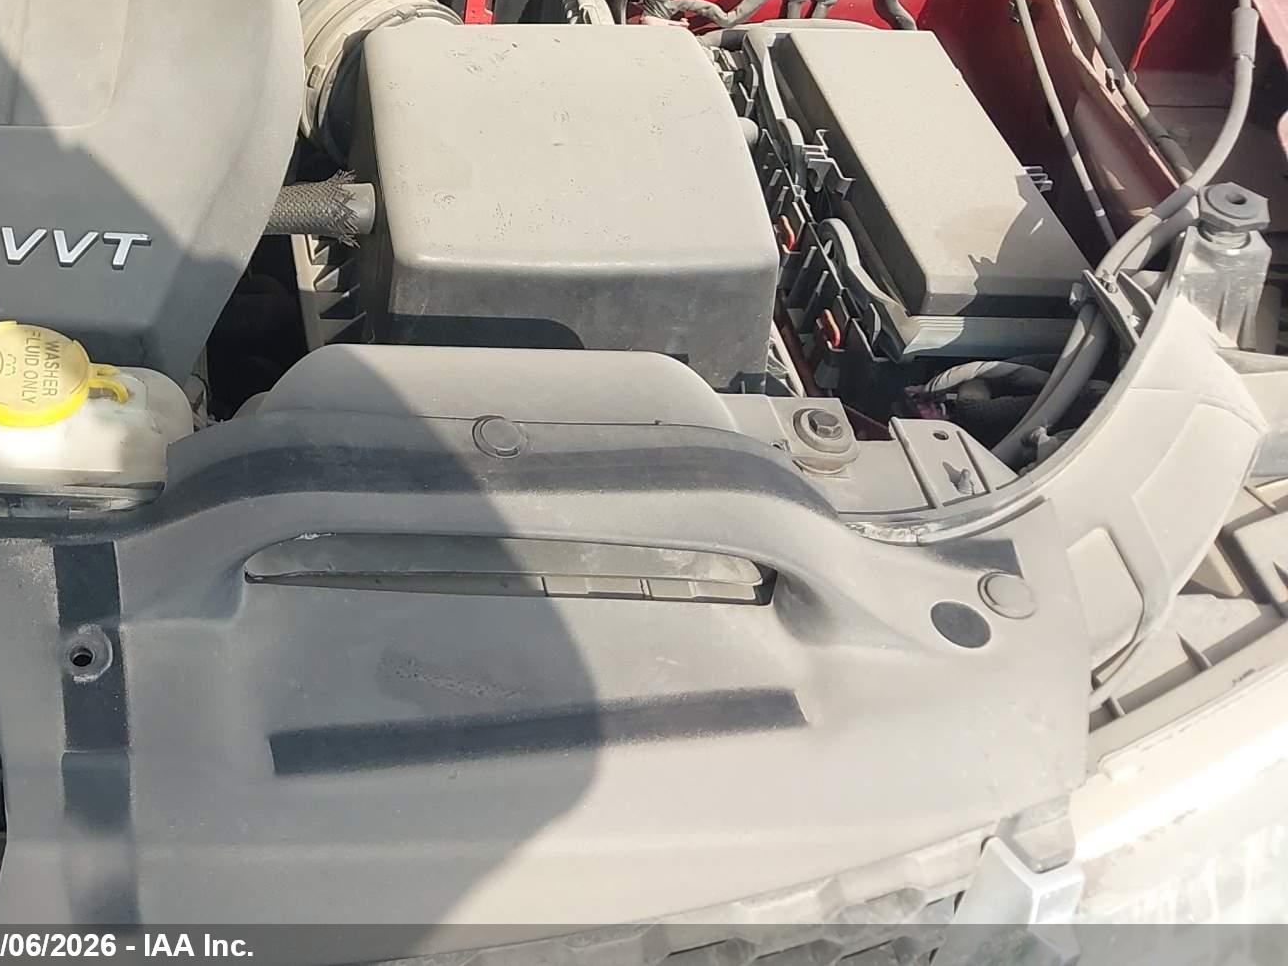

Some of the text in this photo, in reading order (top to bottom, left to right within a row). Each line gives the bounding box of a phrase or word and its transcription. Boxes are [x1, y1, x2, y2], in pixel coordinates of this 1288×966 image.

[0, 225, 152, 271] VVT
[21, 330, 41, 404] FLUID ONLY
[43, 340, 60, 396] WASHER
